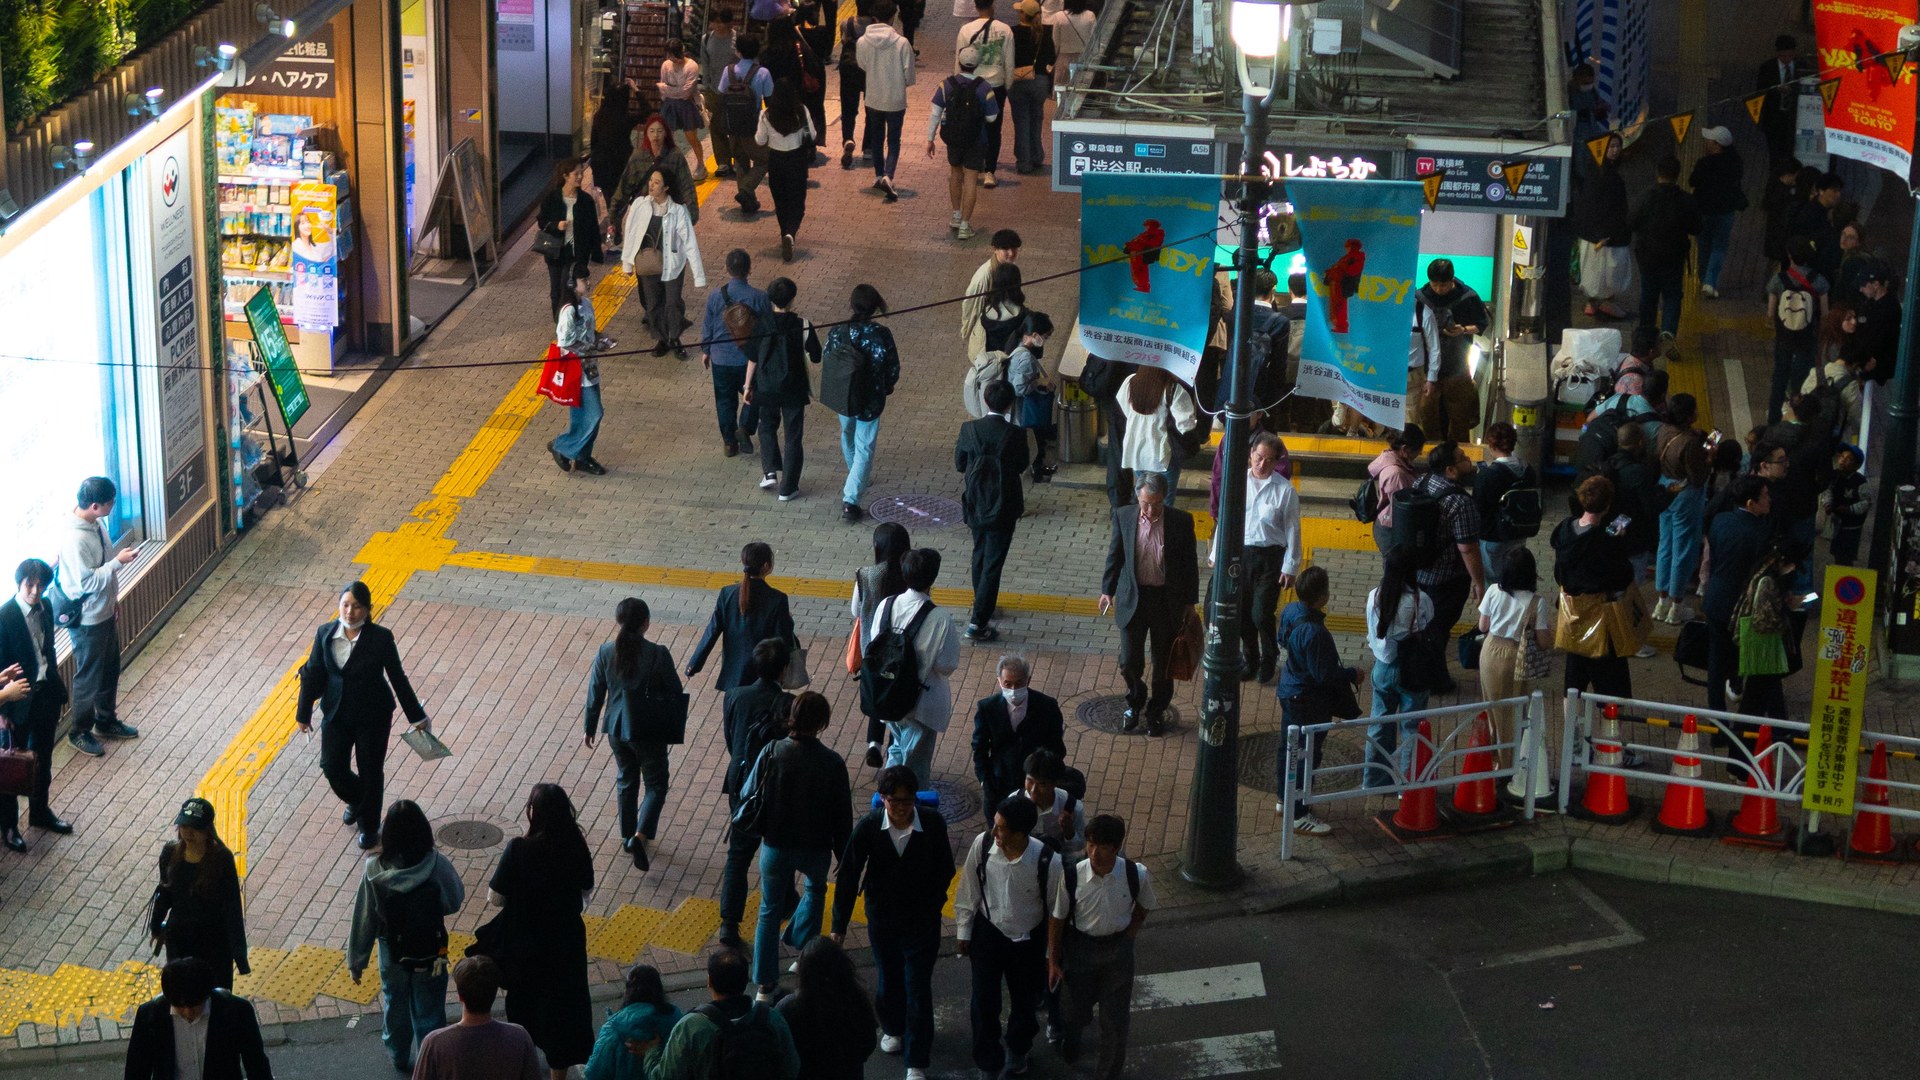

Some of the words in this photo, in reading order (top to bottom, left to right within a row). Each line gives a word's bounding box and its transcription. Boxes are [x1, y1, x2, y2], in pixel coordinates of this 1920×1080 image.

[1853, 113, 1893, 132] TOKYO
[1092, 158, 1142, 174] 渋谷駅
[1083, 328, 1198, 366] 渋谷道玄坂商店街振興組合
[178, 464, 194, 501] 3F
